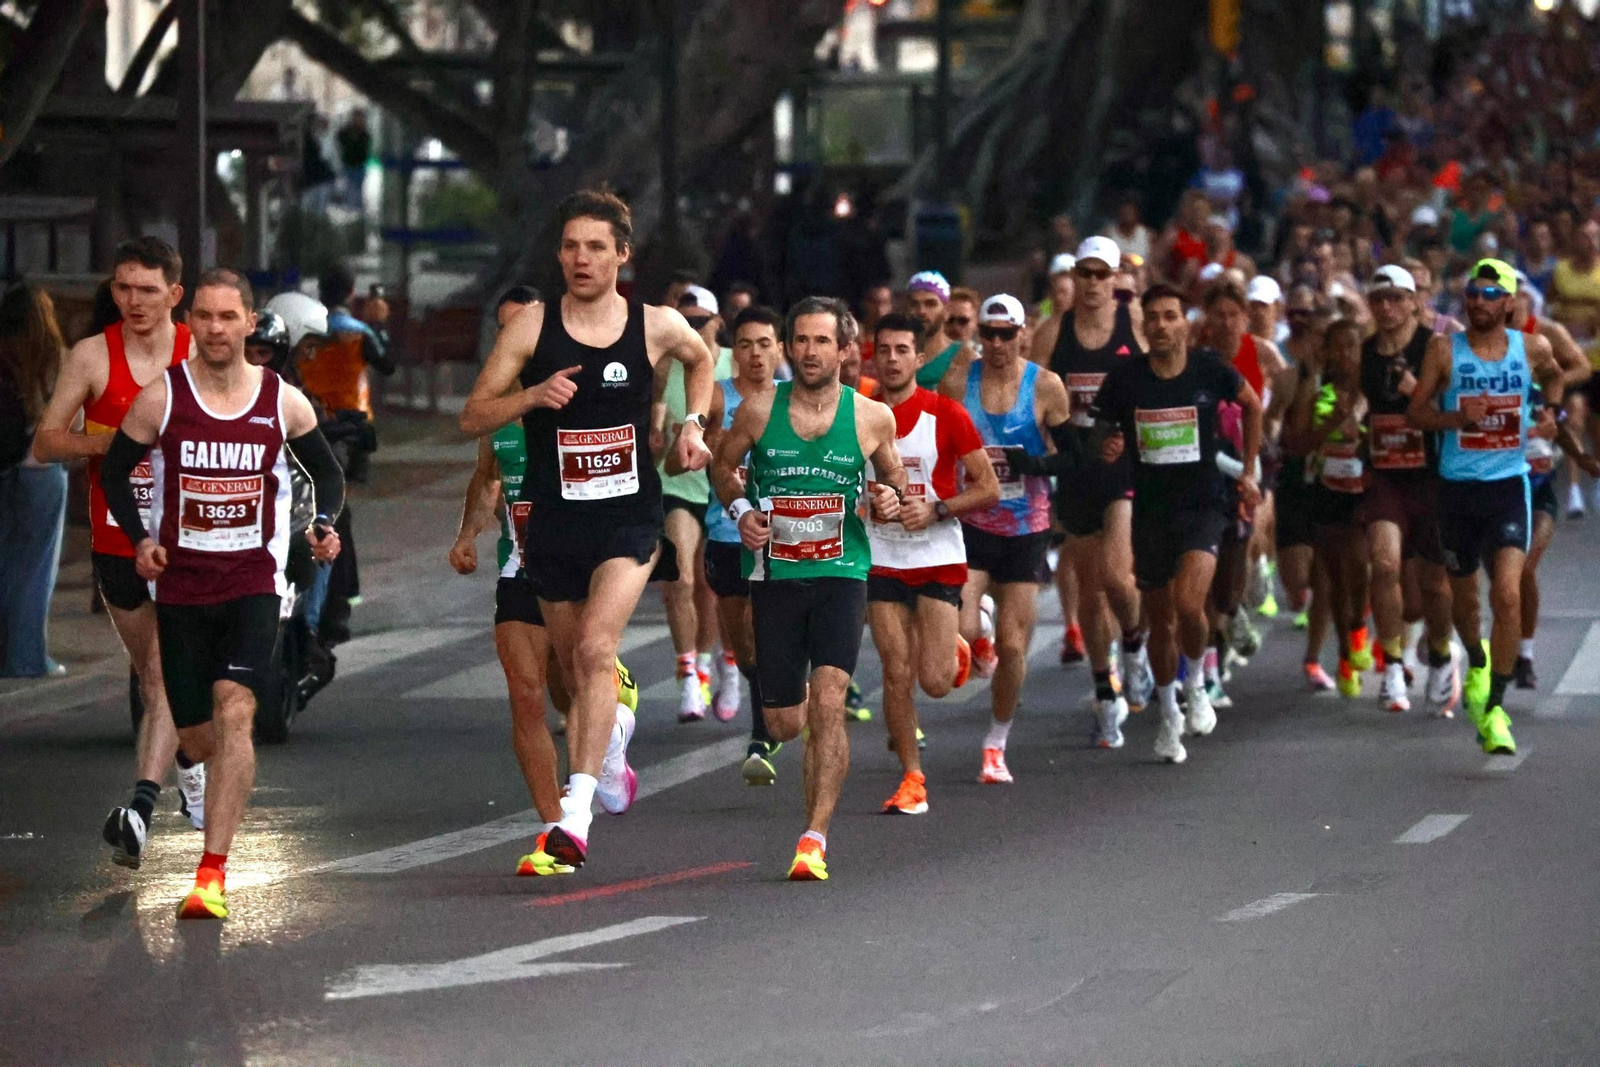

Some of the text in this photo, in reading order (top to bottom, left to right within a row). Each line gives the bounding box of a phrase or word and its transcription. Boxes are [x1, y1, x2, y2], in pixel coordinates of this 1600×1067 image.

[1461, 371, 1522, 393] nerja
[578, 429, 629, 444] GENERALI
[180, 440, 266, 471] GALWAY
[575, 452, 621, 469] 11626
[202, 480, 258, 493] GENERALI
[197, 503, 247, 519] 13623
[788, 499, 838, 510] GENERALI
[788, 520, 824, 533] 7903
